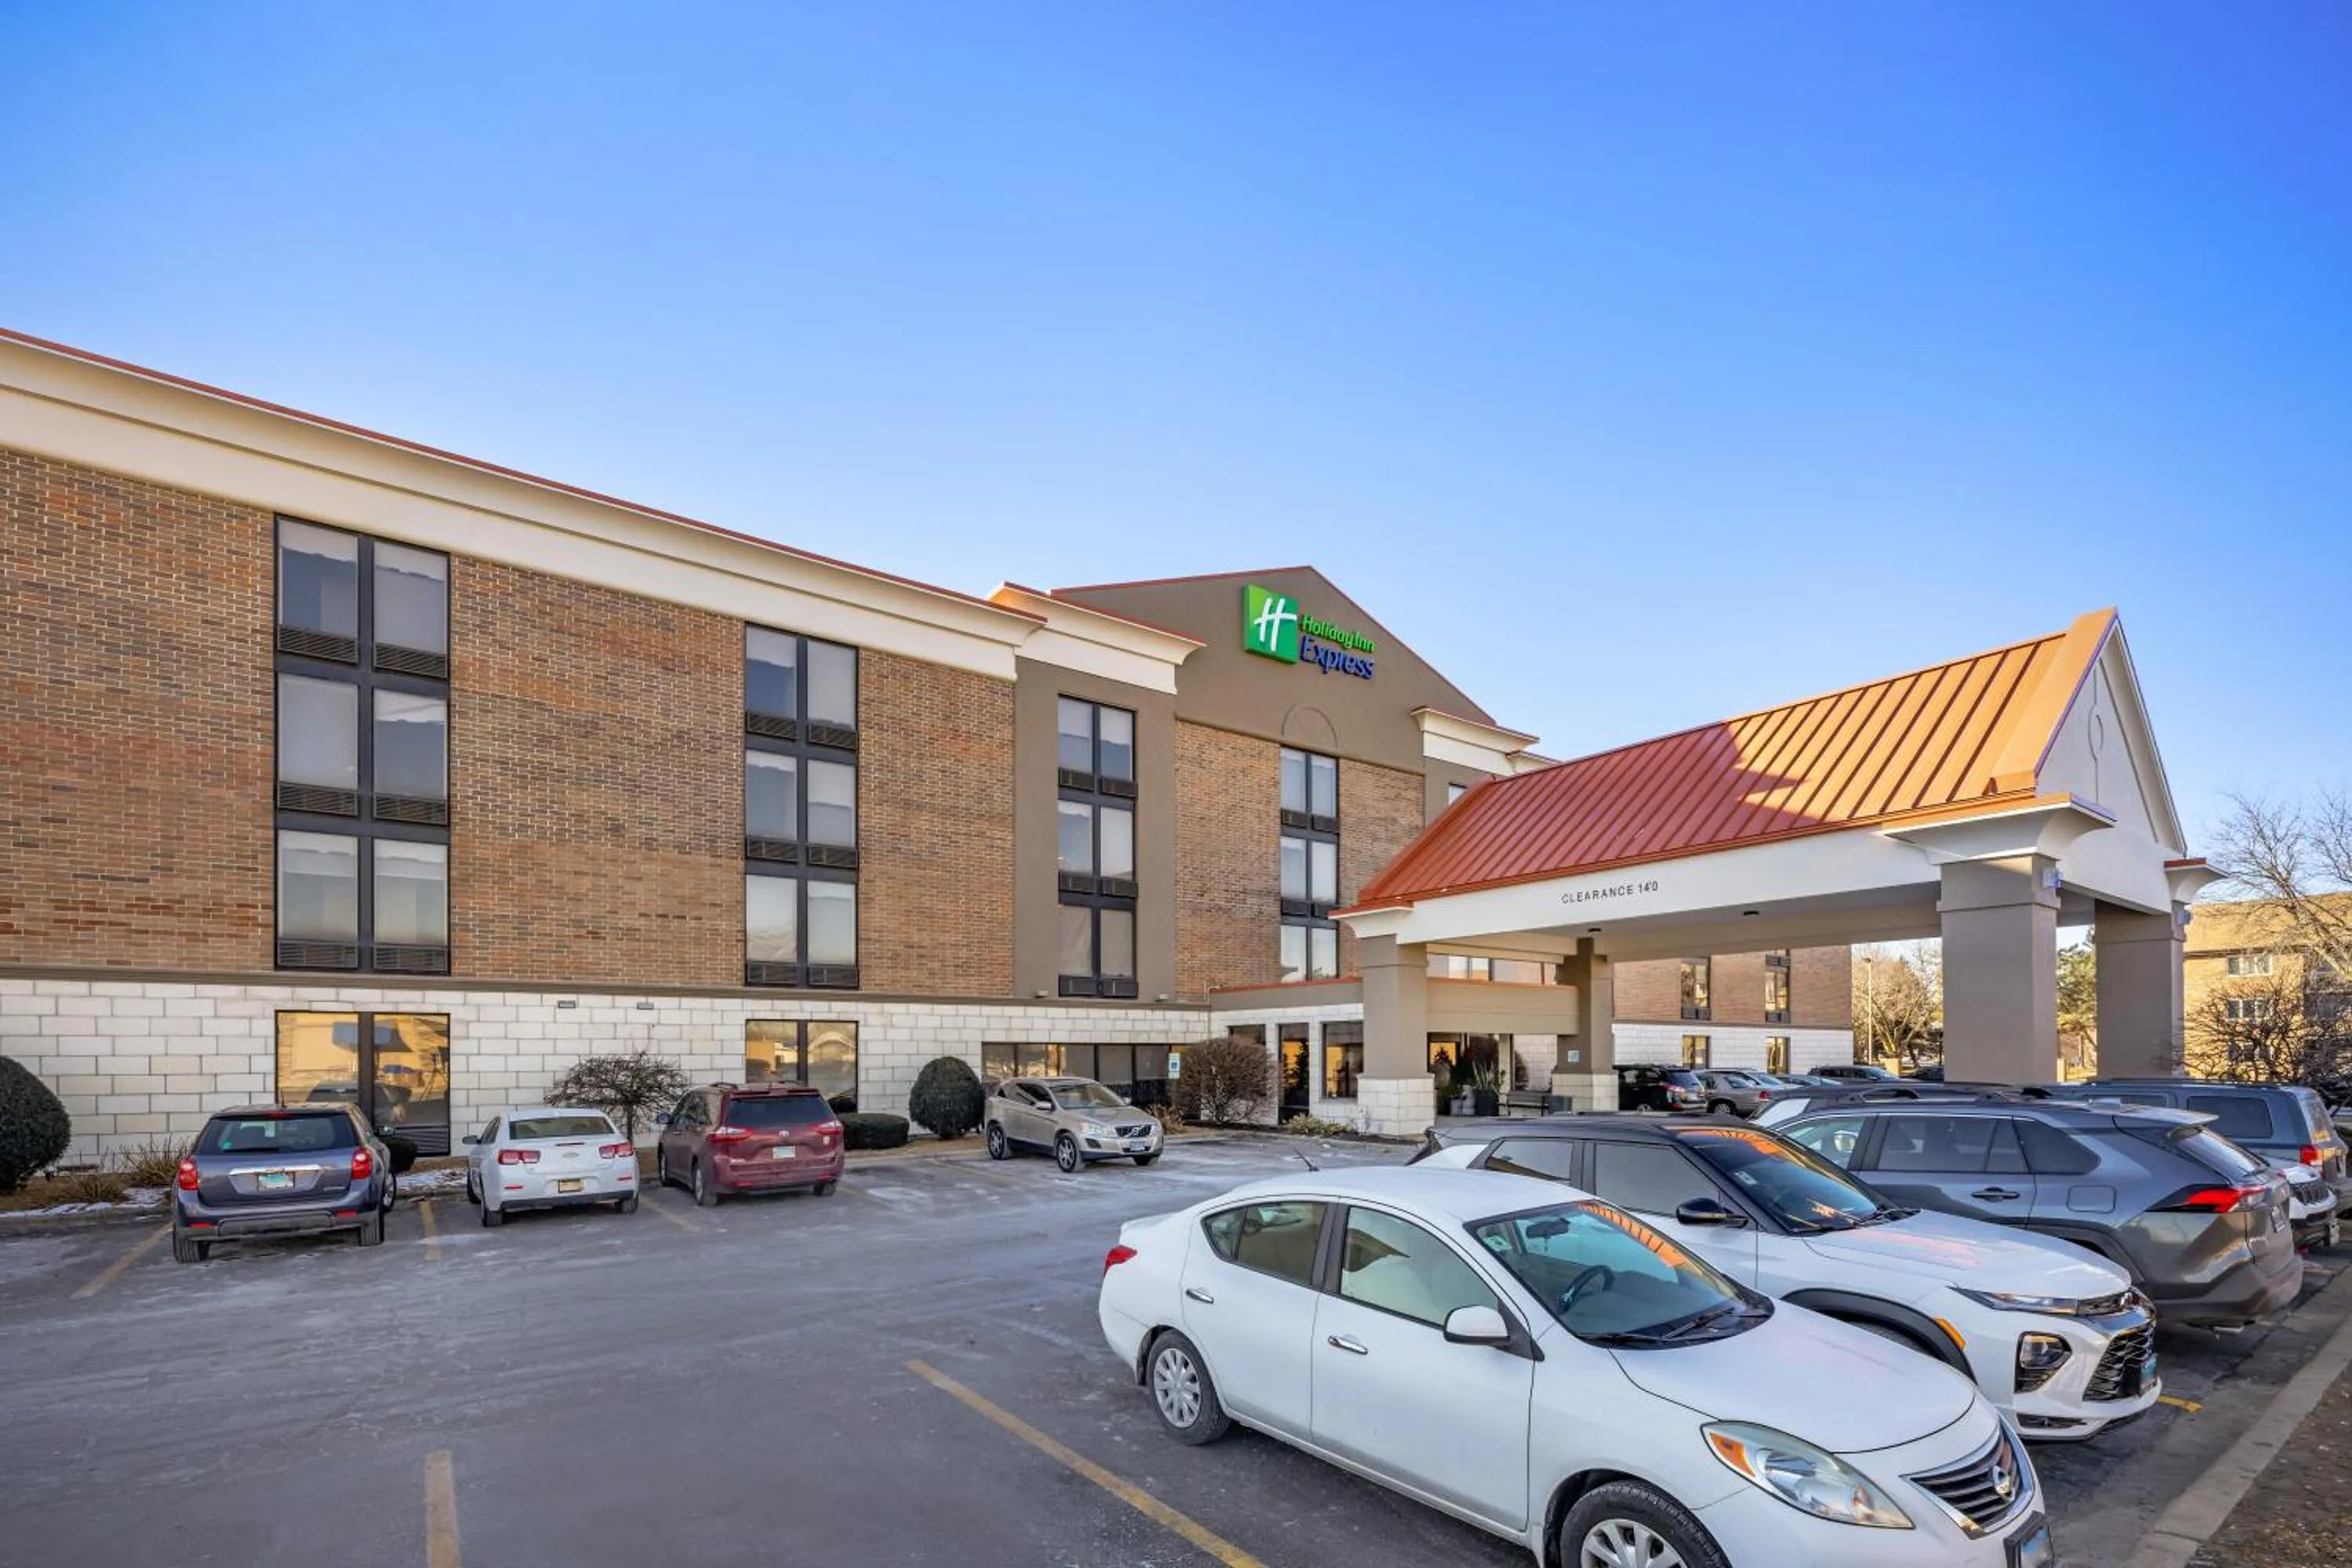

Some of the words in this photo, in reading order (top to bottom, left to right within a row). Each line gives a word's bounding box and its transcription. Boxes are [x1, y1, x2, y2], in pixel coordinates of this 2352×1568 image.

[1301, 615, 1353, 649] Holiday
[1355, 630, 1374, 653] Inn
[1301, 635, 1374, 680] Express
[1562, 884, 1634, 903] CLEARANCE
